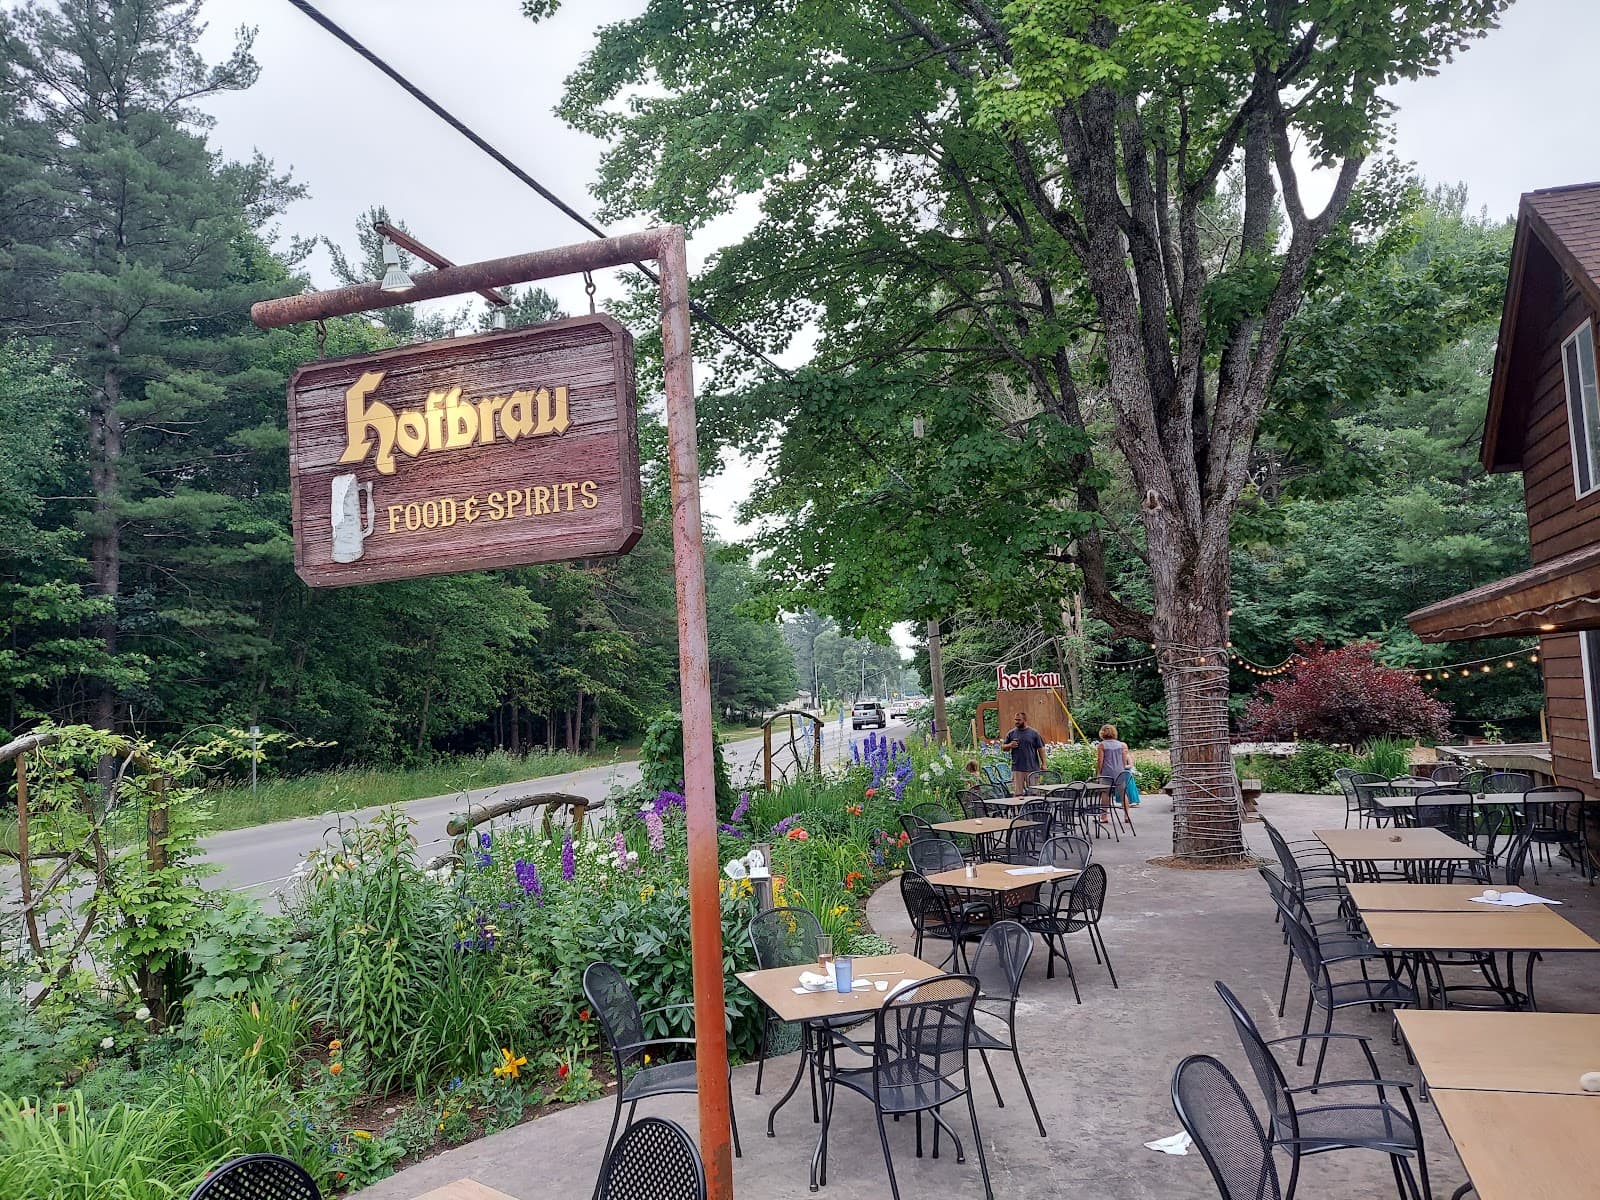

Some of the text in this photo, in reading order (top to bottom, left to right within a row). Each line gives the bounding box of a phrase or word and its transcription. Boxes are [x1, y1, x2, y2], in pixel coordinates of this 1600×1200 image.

[338, 371, 573, 475] hofbrau
[387, 480, 599, 533] FOOD & SPIRITS
[997, 664, 1061, 691] hofbrau
